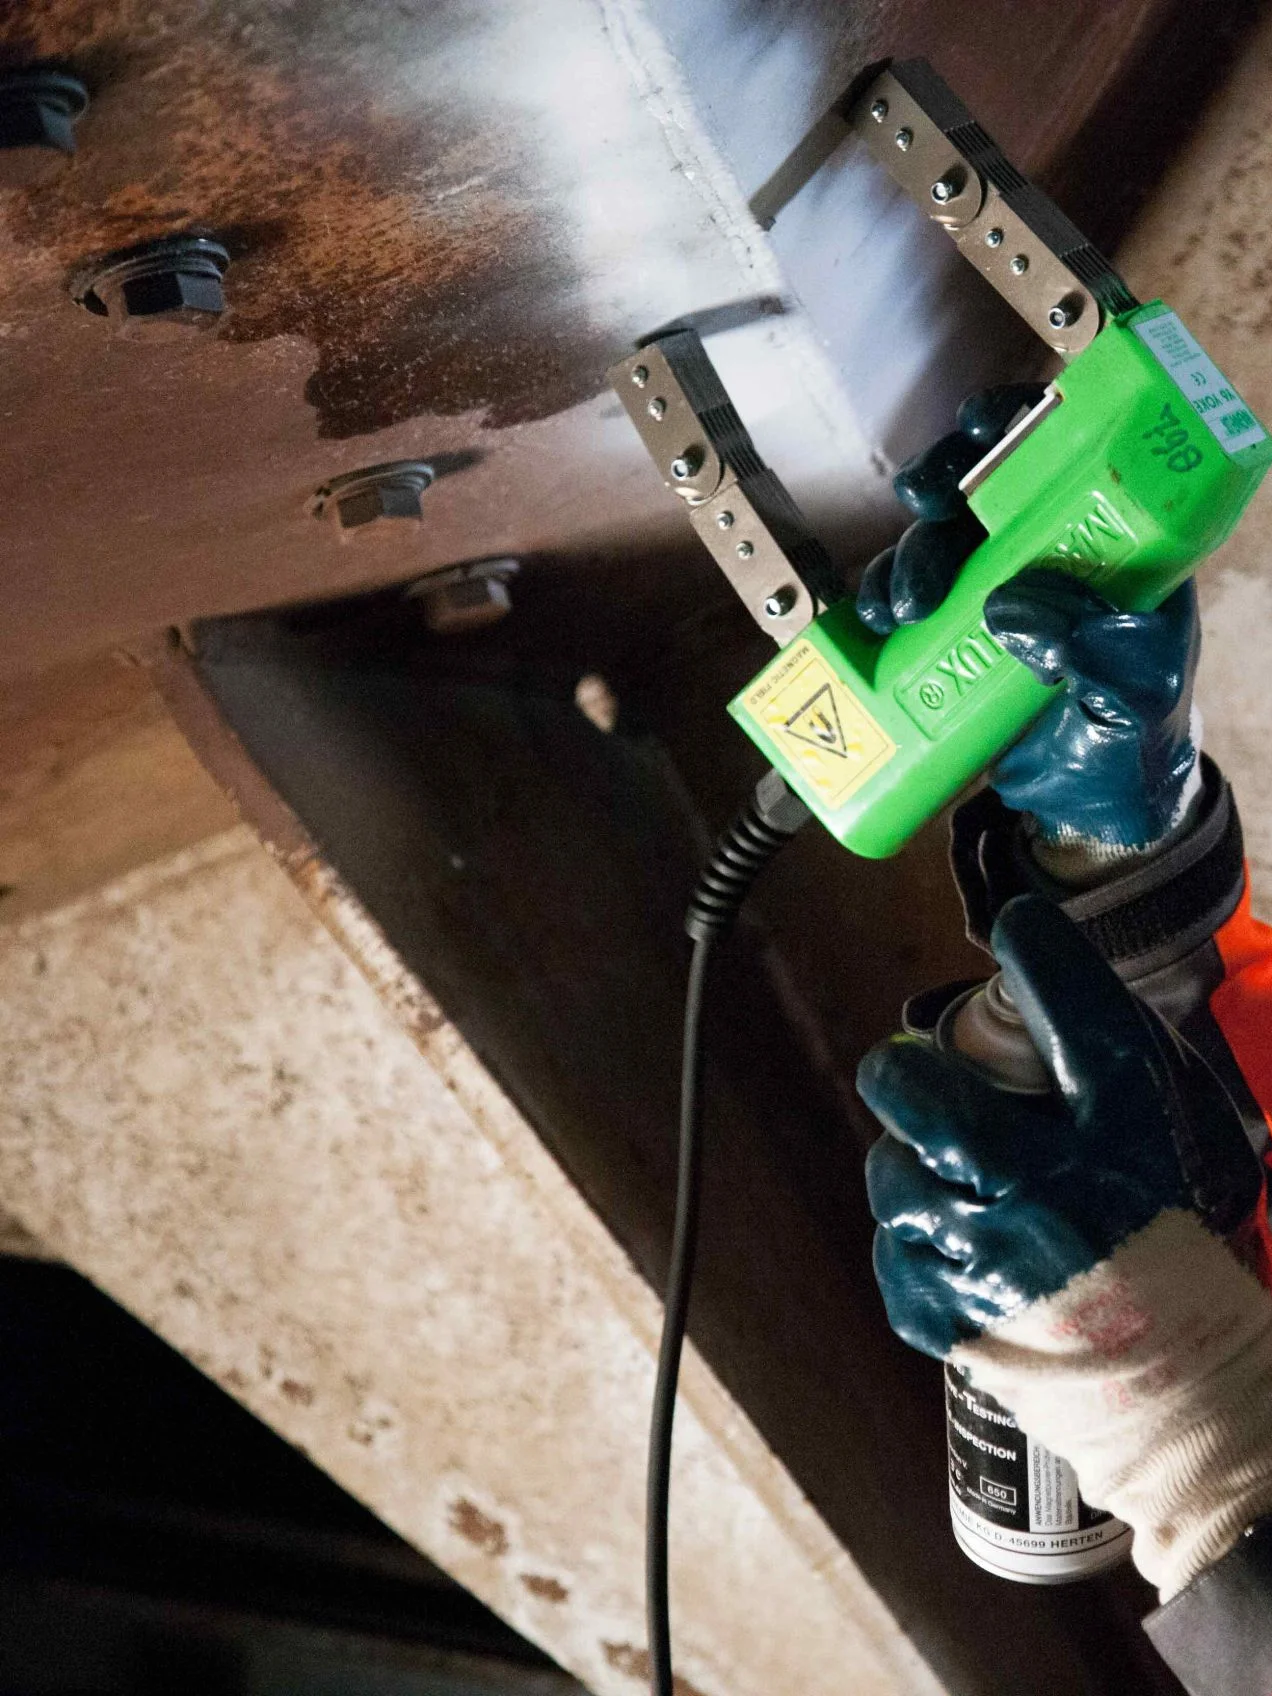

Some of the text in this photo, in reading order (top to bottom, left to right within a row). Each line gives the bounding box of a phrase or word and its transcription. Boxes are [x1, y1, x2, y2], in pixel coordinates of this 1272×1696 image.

[770, 646, 809, 685] MAGNETIC
[987, 1499, 1018, 1516] Germany
[1050, 1531, 1104, 1549] HERTEN
